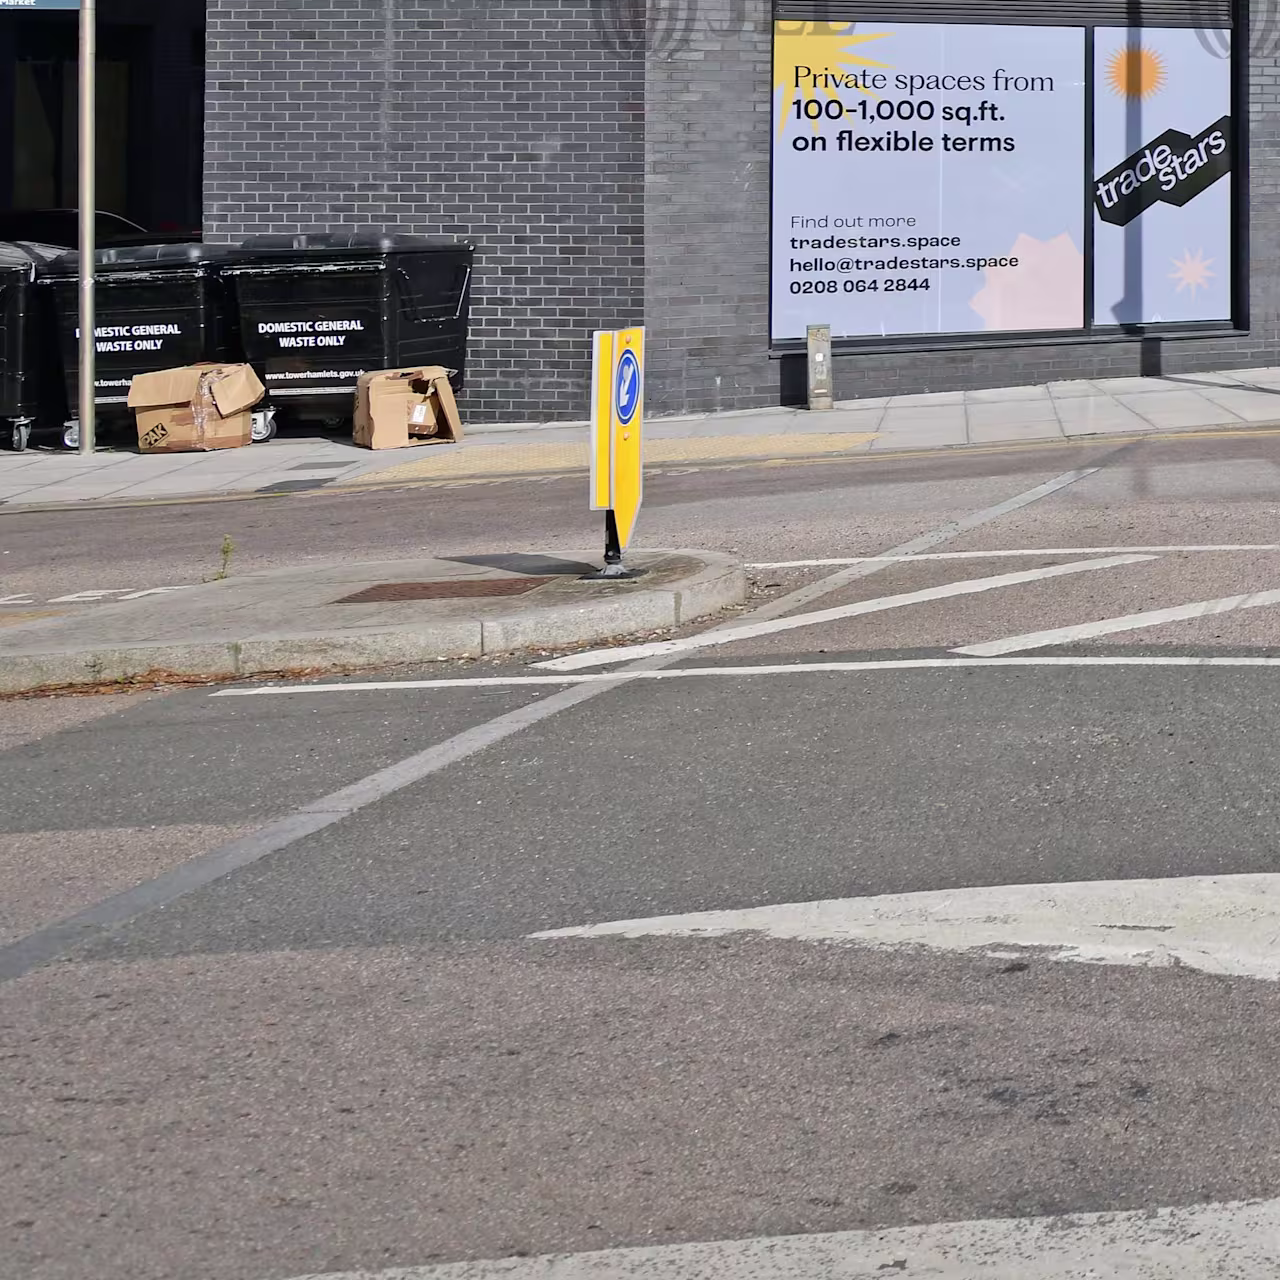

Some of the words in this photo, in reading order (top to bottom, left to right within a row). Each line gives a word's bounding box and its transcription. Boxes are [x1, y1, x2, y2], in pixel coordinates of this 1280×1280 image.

[794, 65, 887, 89] Private
[895, 74, 985, 96] spaces
[992, 68, 1054, 91] from
[792, 99, 935, 124] 100-1,000
[942, 100, 1005, 126] sq.ft.
[792, 136, 826, 151] on
[836, 130, 933, 151] flexible
[941, 134, 1015, 151] terms
[1158, 130, 1226, 191] stars
[1096, 145, 1172, 208] trade
[791, 215, 828, 228] Find
[833, 217, 864, 228] out
[868, 217, 916, 228] more
[790, 235, 960, 250] tradestars.space
[790, 256, 1018, 274] hello@tradestars.space
[789, 280, 838, 294] 0208
[843, 280, 878, 293] 064
[884, 278, 930, 292] 2844
[132, 324, 181, 336] GENERAL
[258, 321, 313, 333] DOMESTIC
[314, 320, 364, 332] GENERAL
[96, 340, 133, 352] WASTE
[134, 339, 163, 350] ONLY
[279, 336, 316, 348] WASTE
[317, 335, 346, 346] ONLY
[265, 369, 365, 380] www.towerhamlets.gov.uk
[141, 423, 168, 445] PAK
